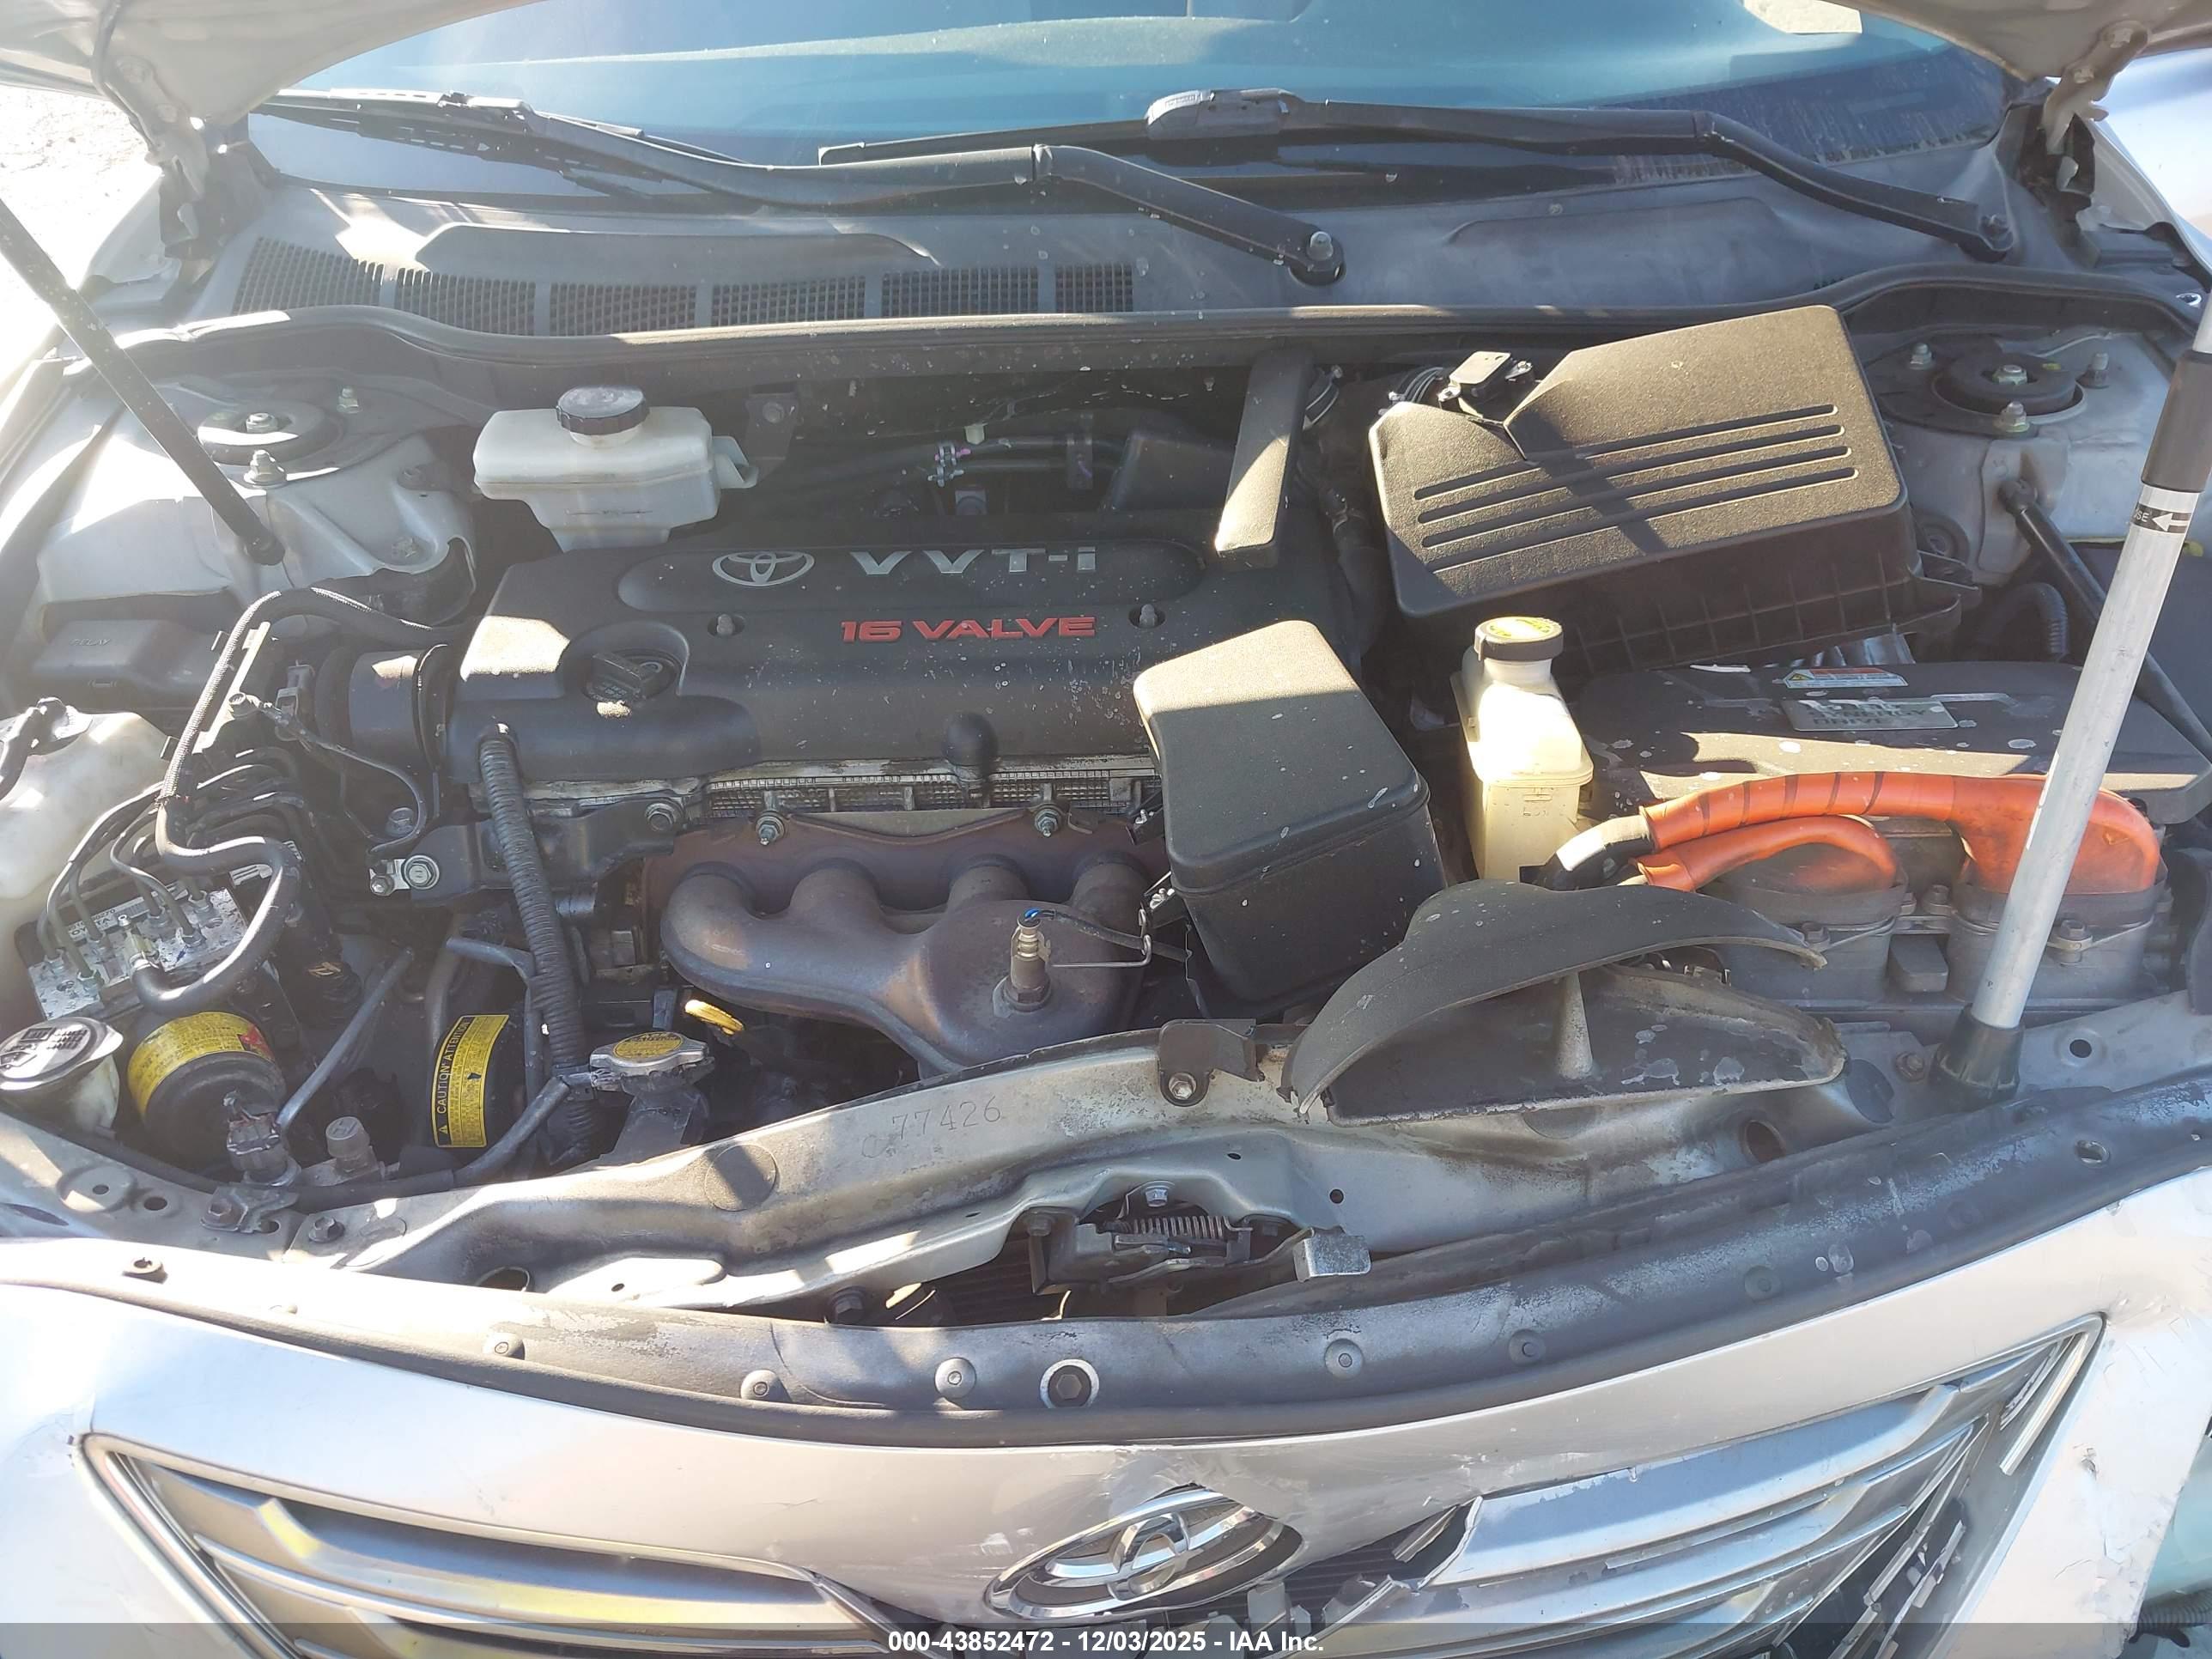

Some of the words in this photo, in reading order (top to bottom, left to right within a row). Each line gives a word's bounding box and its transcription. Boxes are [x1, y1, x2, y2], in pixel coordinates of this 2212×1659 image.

[851, 548, 1097, 574] VVT-i
[842, 620, 902, 642] 16
[913, 617, 1096, 640] VALVE
[436, 1064, 450, 1114] CAUTION
[445, 1021, 471, 1060] ATTENTION
[891, 1095, 1001, 1140] 77426
